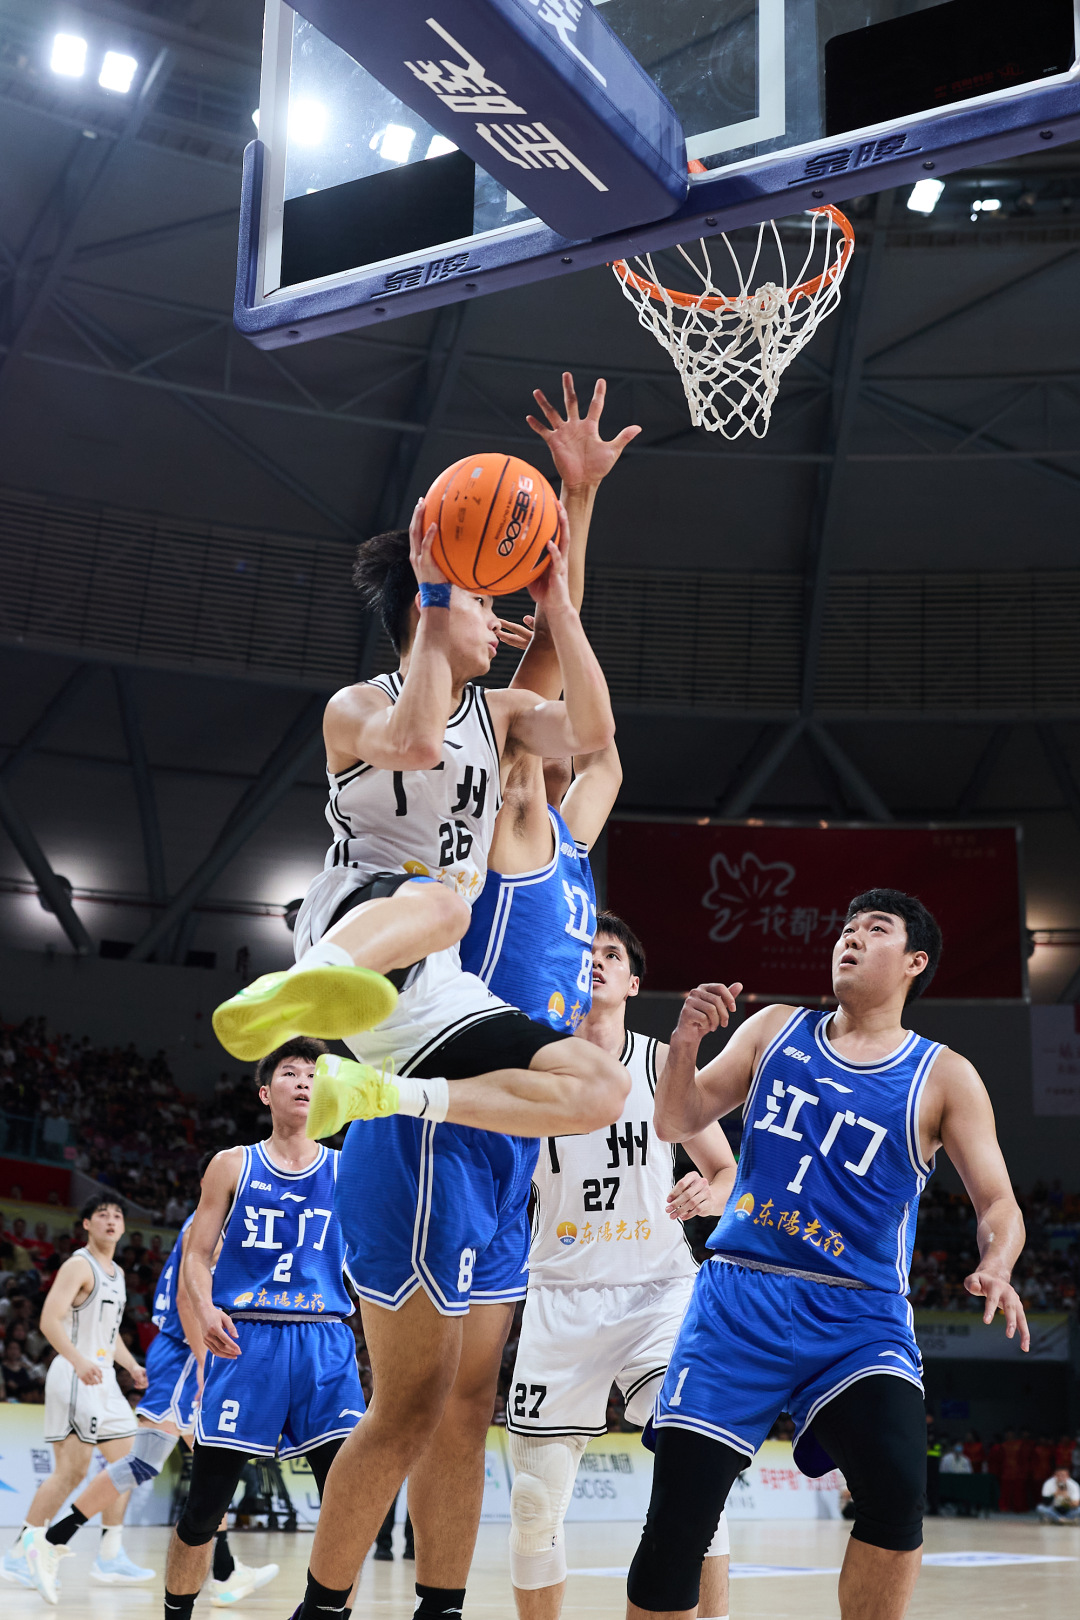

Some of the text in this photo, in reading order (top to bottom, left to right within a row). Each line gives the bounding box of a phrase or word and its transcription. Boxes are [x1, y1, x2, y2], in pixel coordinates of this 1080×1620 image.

[439, 820, 473, 867] 26
[576, 950, 593, 993] 8
[753, 1079, 888, 1176] 江门
[582, 1177, 620, 1211] 27
[786, 1154, 813, 1194] 1
[241, 1205, 332, 1251] 江门
[272, 1253, 293, 1283] 2
[457, 1248, 474, 1292] 8
[514, 1383, 547, 1418] 27
[668, 1367, 689, 1406] 1
[218, 1399, 240, 1433] 2
